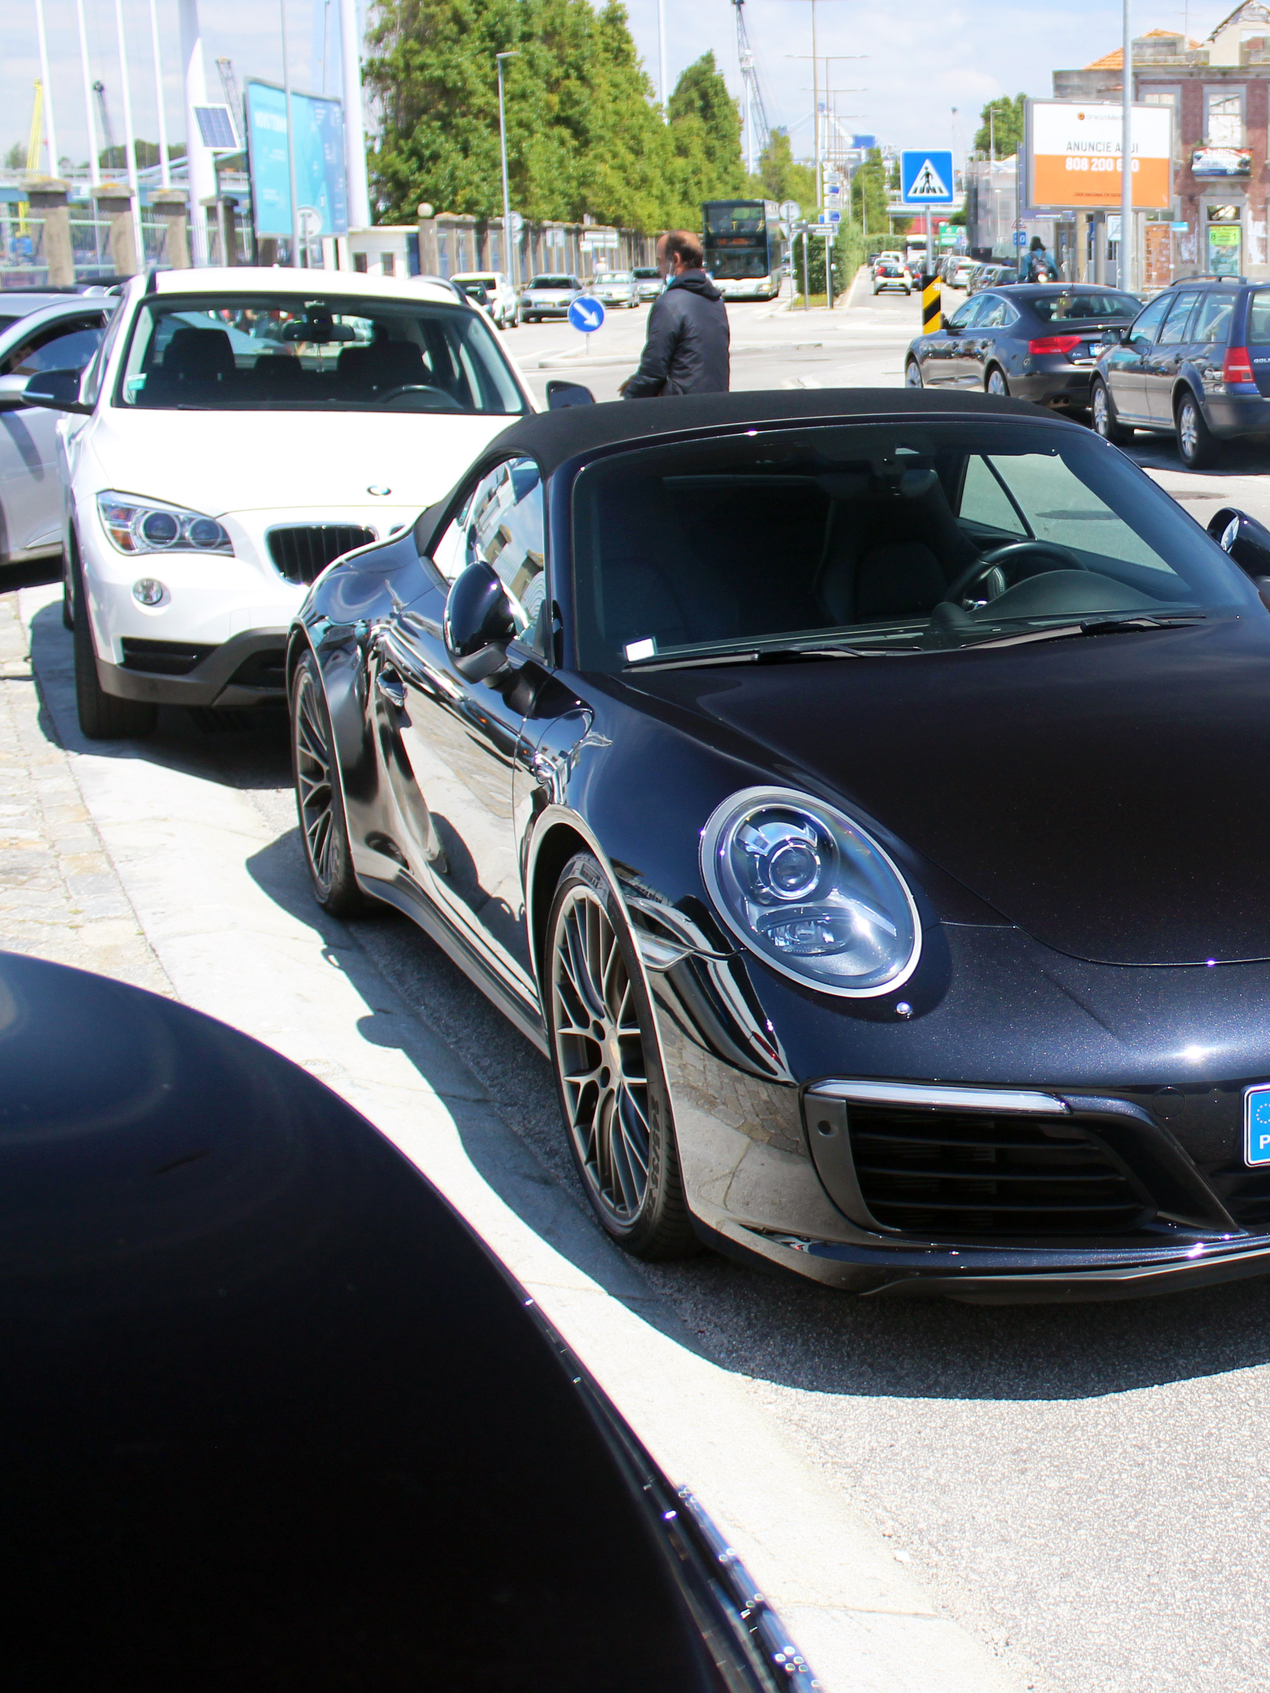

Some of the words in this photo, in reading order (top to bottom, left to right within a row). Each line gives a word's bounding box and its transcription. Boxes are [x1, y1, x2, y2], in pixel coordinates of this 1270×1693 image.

[1066, 141, 1112, 152] ANUNCIE
[1065, 156, 1089, 171] 808
[1090, 157, 1114, 172] 200
